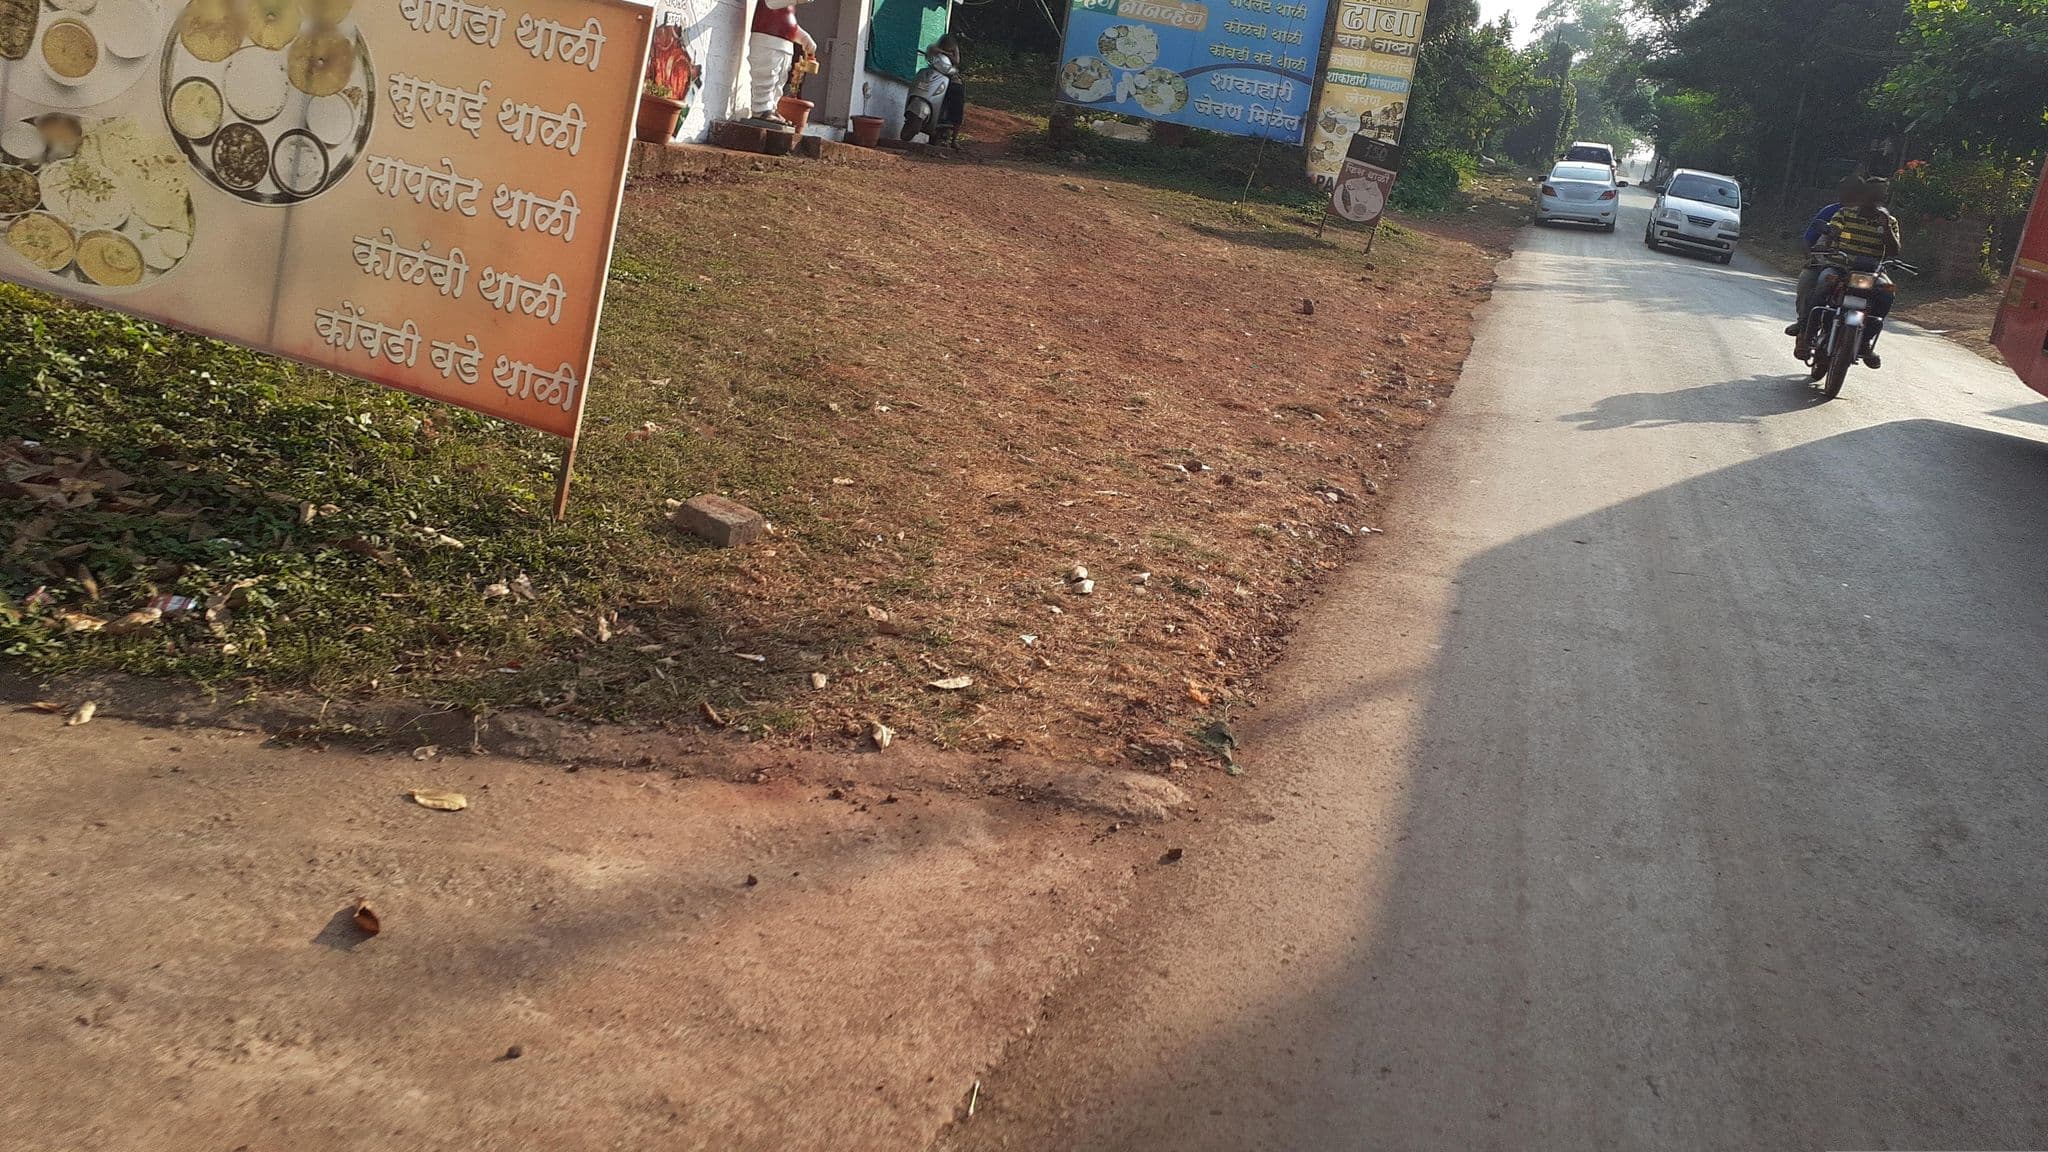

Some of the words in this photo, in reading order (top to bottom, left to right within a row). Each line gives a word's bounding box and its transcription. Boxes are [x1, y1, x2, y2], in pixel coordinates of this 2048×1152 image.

[1276, 3, 1307, 20] थाळी
[1342, 2, 1421, 38] ढाबा
[515, 12, 607, 71] थाळी
[1271, 28, 1304, 46] थाळी
[1337, 34, 1367, 50] चहा
[1277, 55, 1308, 72] थाळी
[1326, 71, 1367, 87] शाकाहारी
[1210, 72, 1294, 102] शाकाहारी
[388, 72, 492, 139] सुरमई
[498, 97, 587, 155] थाळी
[1193, 94, 1243, 120] जेवण
[1248, 103, 1301, 131] मिळेल
[366, 154, 483, 216] पापलेट
[492, 183, 581, 242] थाळी
[352, 228, 469, 298] कोळंबी
[478, 266, 566, 325] थाळी
[315, 301, 422, 367] कोंबडी
[430, 334, 484, 384] वडे
[492, 354, 579, 411] थाळी
